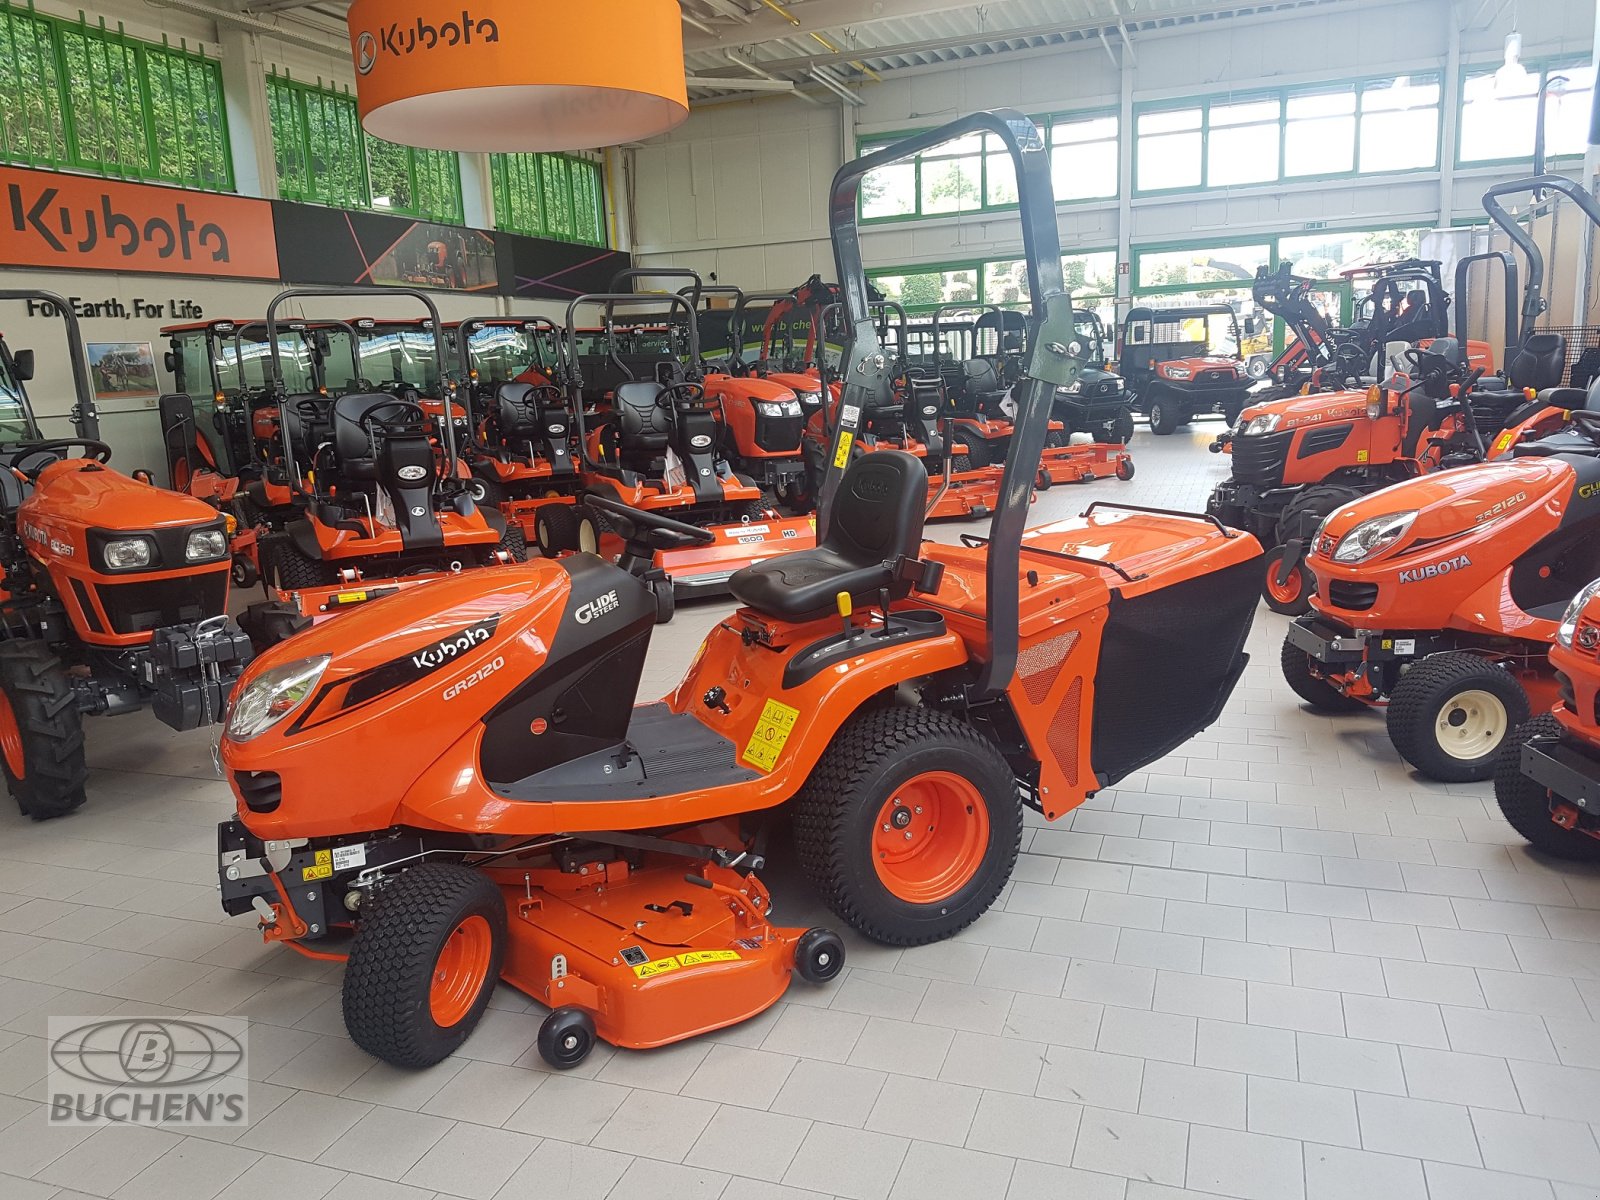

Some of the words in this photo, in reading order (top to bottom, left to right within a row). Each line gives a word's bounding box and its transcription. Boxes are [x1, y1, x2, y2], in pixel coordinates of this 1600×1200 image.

[381, 11, 499, 56] Kubota
[8, 183, 230, 263] Kubota
[134, 299, 164, 318] For
[170, 299, 203, 319] Life
[1399, 554, 1473, 584] KUBOTA
[575, 590, 618, 624] GLIDE
[593, 601, 619, 618] STEER
[412, 627, 490, 669] Kubota
[442, 655, 505, 701] GR2120
